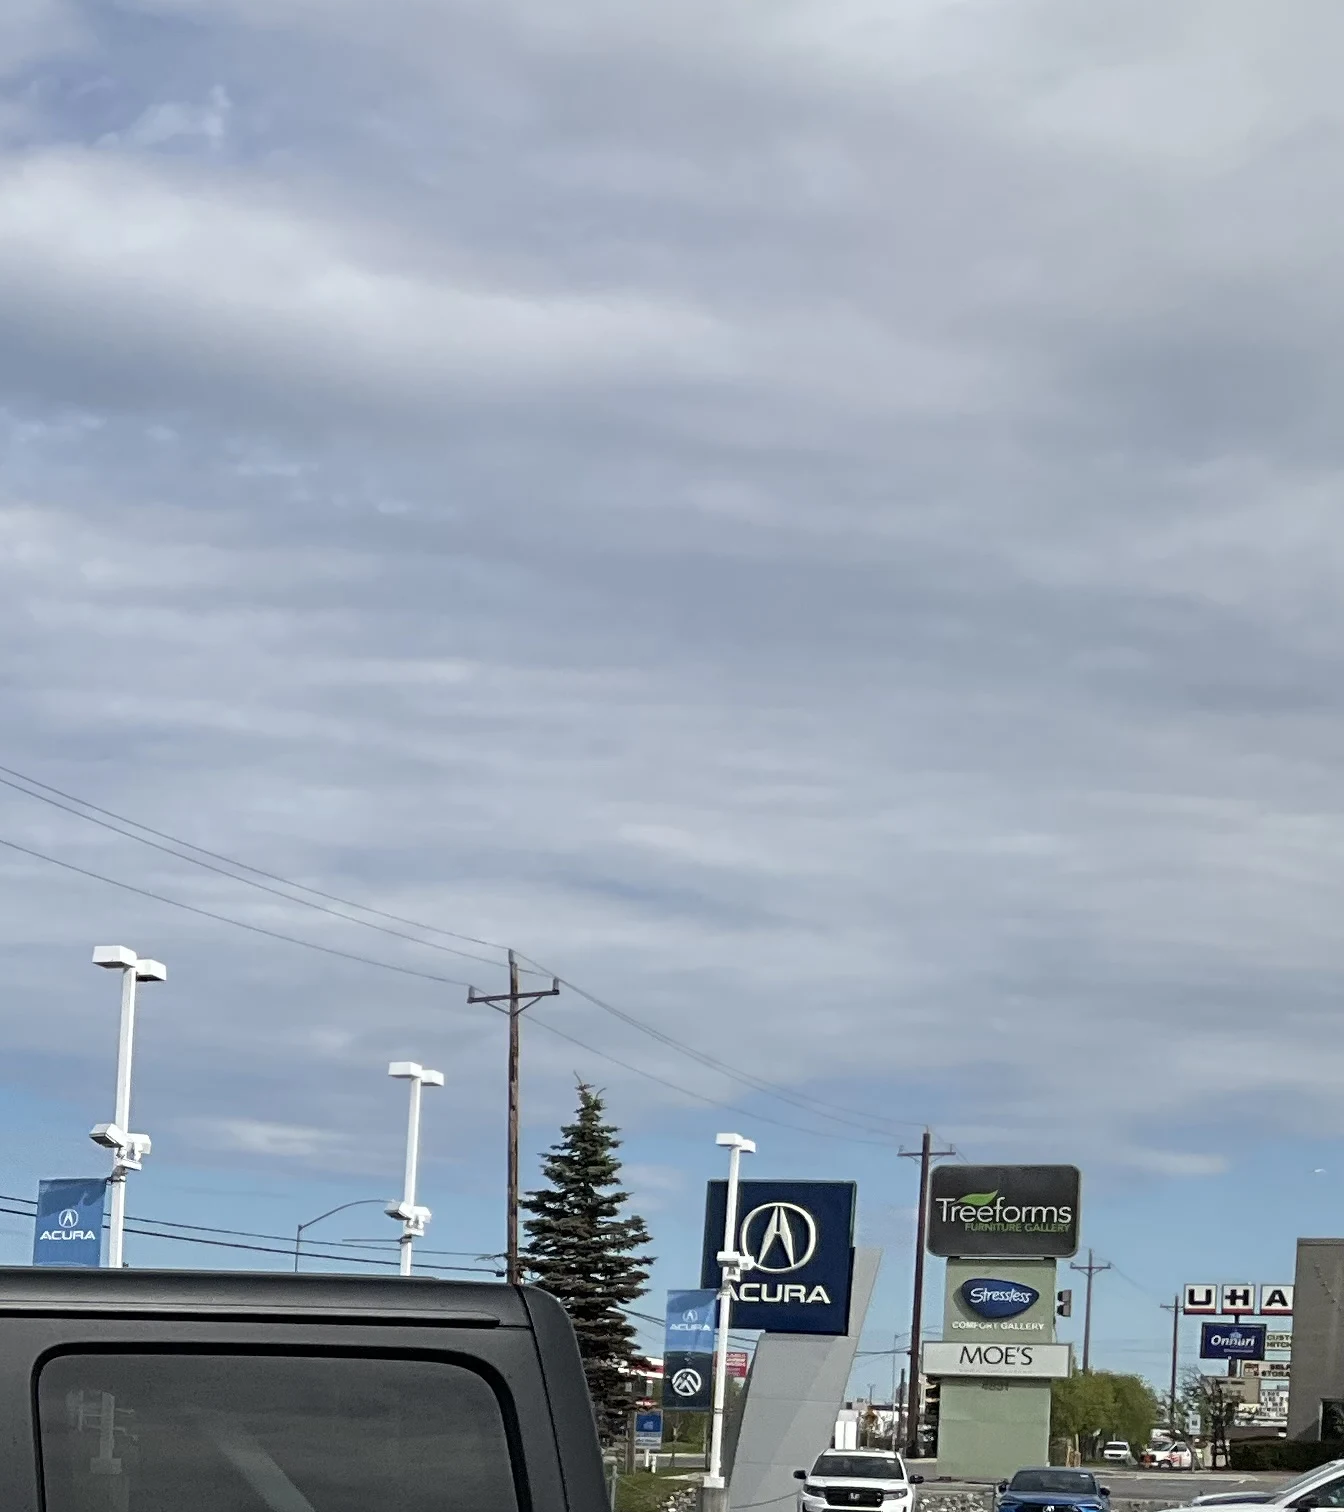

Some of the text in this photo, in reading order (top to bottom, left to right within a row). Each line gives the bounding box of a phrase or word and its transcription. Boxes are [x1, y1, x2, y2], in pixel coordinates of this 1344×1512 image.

[936, 1196, 1072, 1223] Treeforms
[965, 1223, 1072, 1233] FURNITURE GALLERY
[40, 1230, 96, 1240] ACURA
[970, 1287, 1033, 1303] Stressless
[669, 1323, 712, 1332] ACURA
[952, 1321, 1045, 1331] COMFORT GALLERY
[1211, 1335, 1256, 1347] Onnuri
[959, 1346, 1033, 1366] MOE'S
